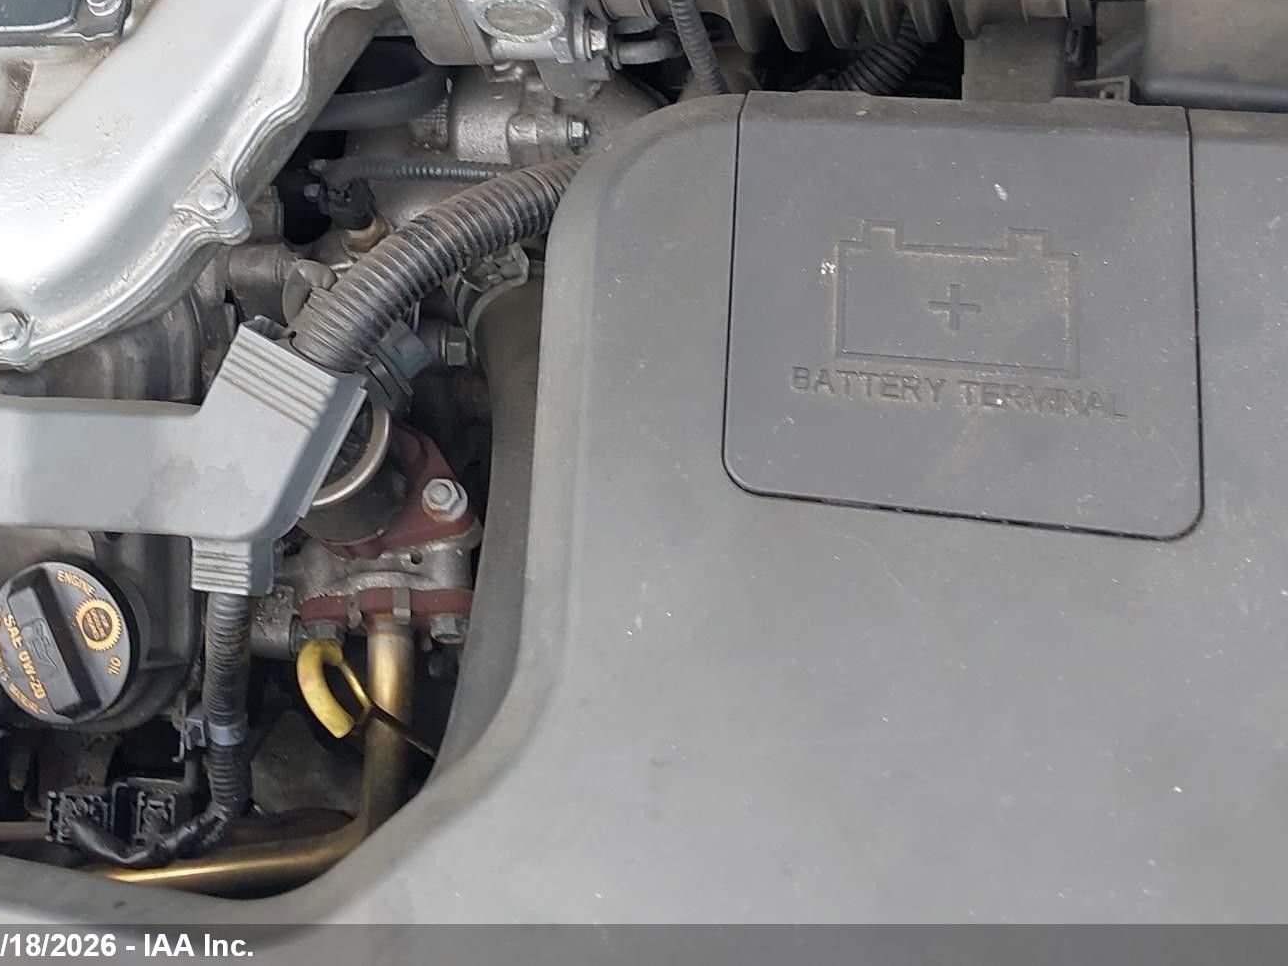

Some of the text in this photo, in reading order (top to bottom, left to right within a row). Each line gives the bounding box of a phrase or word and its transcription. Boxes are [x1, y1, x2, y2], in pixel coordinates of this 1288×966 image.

[790, 365, 1128, 420] BATTERY TERMINAL
[56, 570, 96, 598] ENGINE
[3, 614, 24, 649] SAE
[107, 655, 123, 676] OIL
